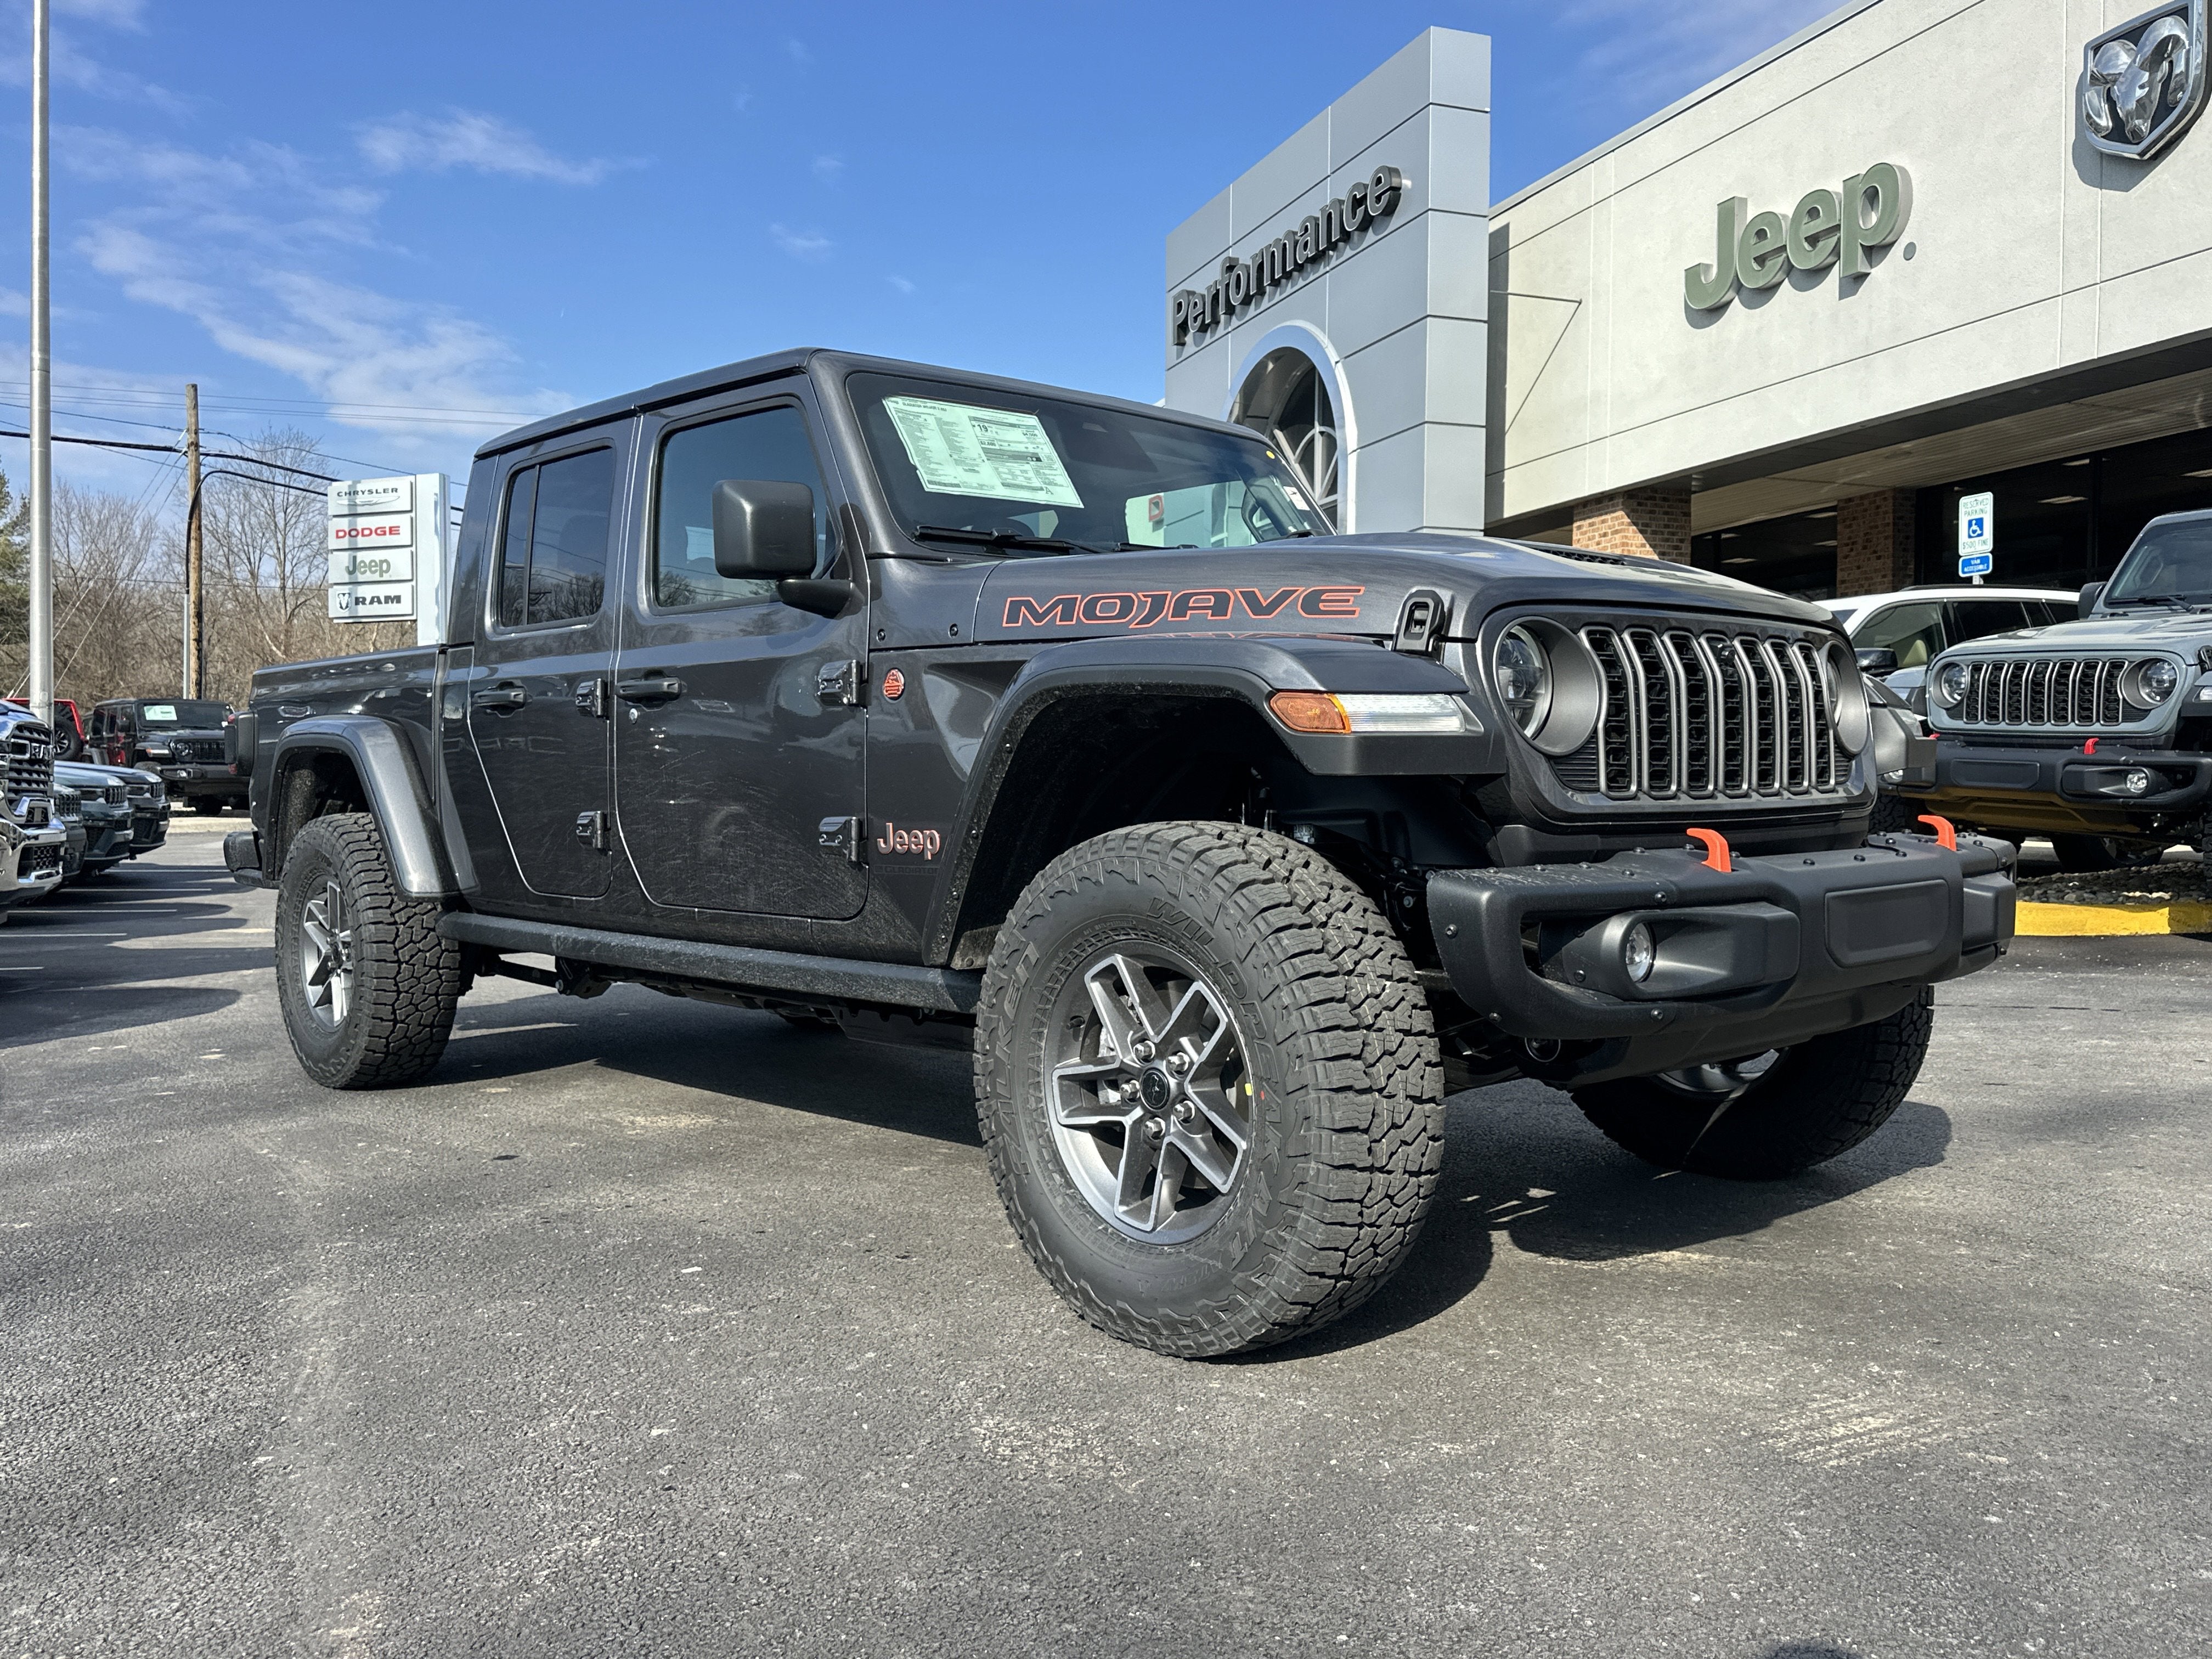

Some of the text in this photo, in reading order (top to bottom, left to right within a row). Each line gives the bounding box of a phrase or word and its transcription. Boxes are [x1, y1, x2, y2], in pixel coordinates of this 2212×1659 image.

[1684, 162, 1913, 309] Jeep
[1172, 165, 1402, 346] Performance
[337, 487, 398, 497] CHRYSLER
[1963, 498, 1989, 509] RESERVED
[1964, 507, 1988, 517] PARKING
[335, 525, 401, 539] DODGE
[1978, 538, 1989, 547] FINE
[345, 555, 391, 578] Jeep
[354, 595, 402, 606] RAM
[1002, 586, 1365, 629] MOJAVE
[877, 822, 940, 861] Jeep
[1147, 896, 1283, 1177] WILDPEAK
[996, 941, 1040, 1175] FALKEN
